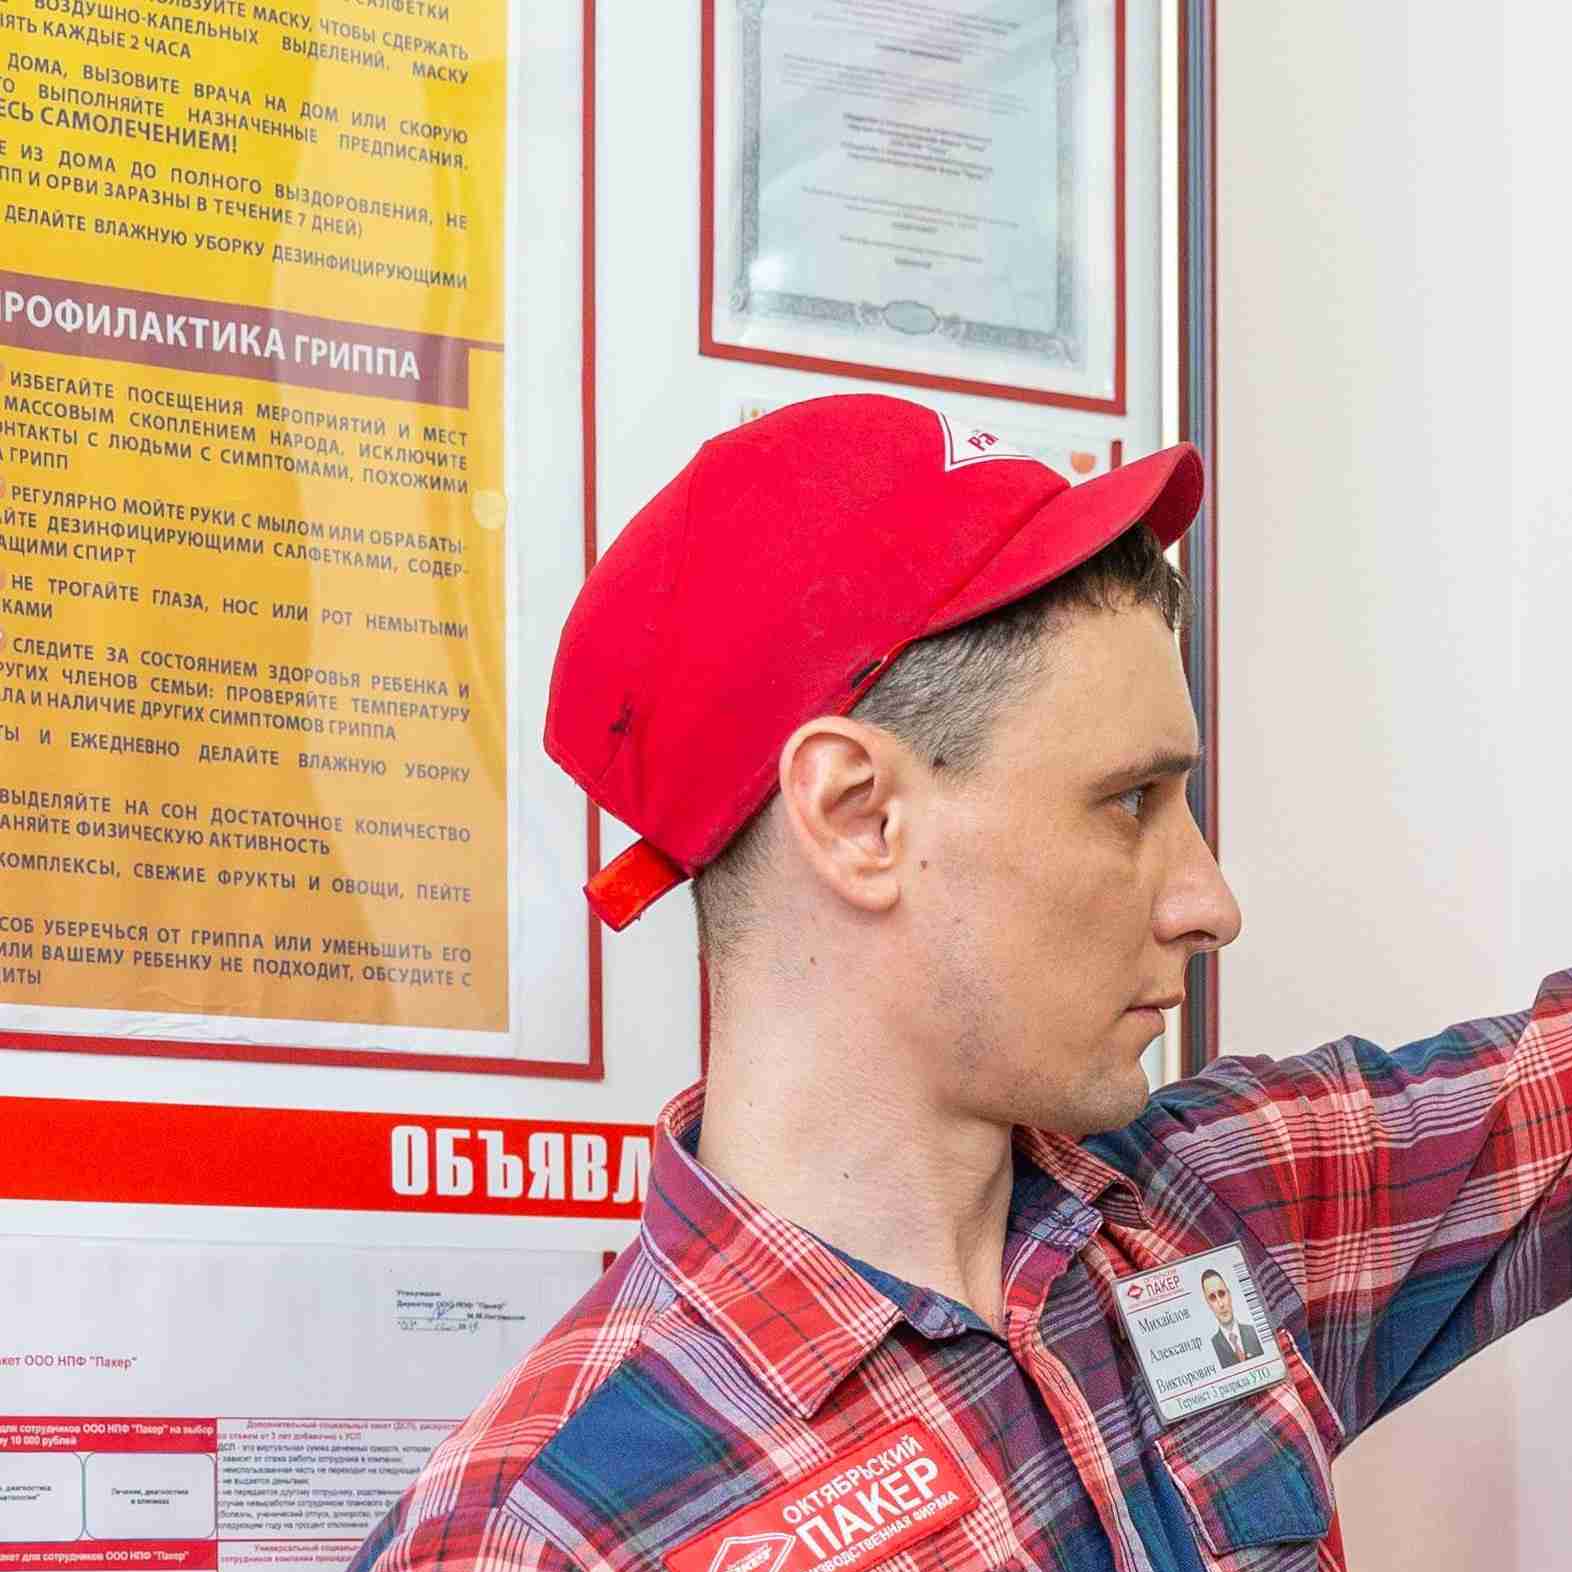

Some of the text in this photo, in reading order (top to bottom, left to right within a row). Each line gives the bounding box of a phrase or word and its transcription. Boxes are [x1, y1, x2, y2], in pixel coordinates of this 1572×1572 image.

[7, 52, 468, 145] ДОМА, ВЫЗОВИТЕ ВРАЧА НА ДОМ ИЛИ СКОРУЮ
[38, 83, 469, 170] ВЫПОЛНЯЙТЕ НАЗНАЧЕННЫЕ ПРЕДПИСАНИЯ.
[40, 106, 238, 154] САМОЛЕЧЕНИЕМ!
[21, 143, 43, 162] ИЗ
[58, 150, 117, 173] ДОМА
[130, 161, 157, 179] ДО
[171, 167, 262, 194] ПОЛНОГО
[447, 213, 468, 230] НЕ
[4, 204, 468, 289] ДЕЛАЙТЕ ВЛАЖНУЮ УБОРКУ ДЕЗИНФИЦИРУЮЩИМИ
[0, 289, 421, 381] РОФИЛАКТИКА ГРИППА
[4, 395, 115, 424] МАССОВЫМ
[129, 412, 256, 441] СКОПЛЕНИЕМ
[359, 444, 468, 471] ИСКЛЮЧИТЕ
[10, 370, 469, 447] ИЗБЕГАЙТЕ ПОСЕЩЕНИЯ МЕРОПРИЯТИЙ И МЕСТ
[47, 515, 264, 555] ДЕЗИНФИЦИРУЮЩИМИ
[273, 541, 399, 575] САЛФЕТКАМИ,
[12, 574, 469, 639] НЕ ТРОГАЙТЕ ГЛАЗА, НОС ИЛИ РОТ НЕМЫТЫМИ
[13, 637, 470, 699] СЛЕДИТЕ ЗА СОСТОЯНИЕМ ЗДОРОВЬЯ РЕБЕНКА И
[76, 820, 331, 856] ФИЗИЧЕСКУЮ АКТИВНОСТЬ
[125, 799, 149, 817] НА
[161, 802, 197, 821] СОН
[210, 807, 344, 833] ДОСТАТОЧНОЕ
[354, 817, 471, 844] КОЛИЧЕСТВО
[133, 861, 472, 903] СВЕЖИЕ ФРУКТЫ И ОВОЩИ, ПЕЙТЕ
[44, 919, 472, 963] УБЕРЕЧЬСЯ ОТ ГРИППА ИЛИ УМЕНЬШИТЬ ЕГО
[24, 1354, 54, 1367] ООО
[1156, 1364, 1217, 1394] Викторович
[782, 1434, 924, 1525] ОКТЯБРЬСКИЙ
[795, 1457, 939, 1561] ПАКЕР
[913, 1489, 961, 1523] ФИРМА
